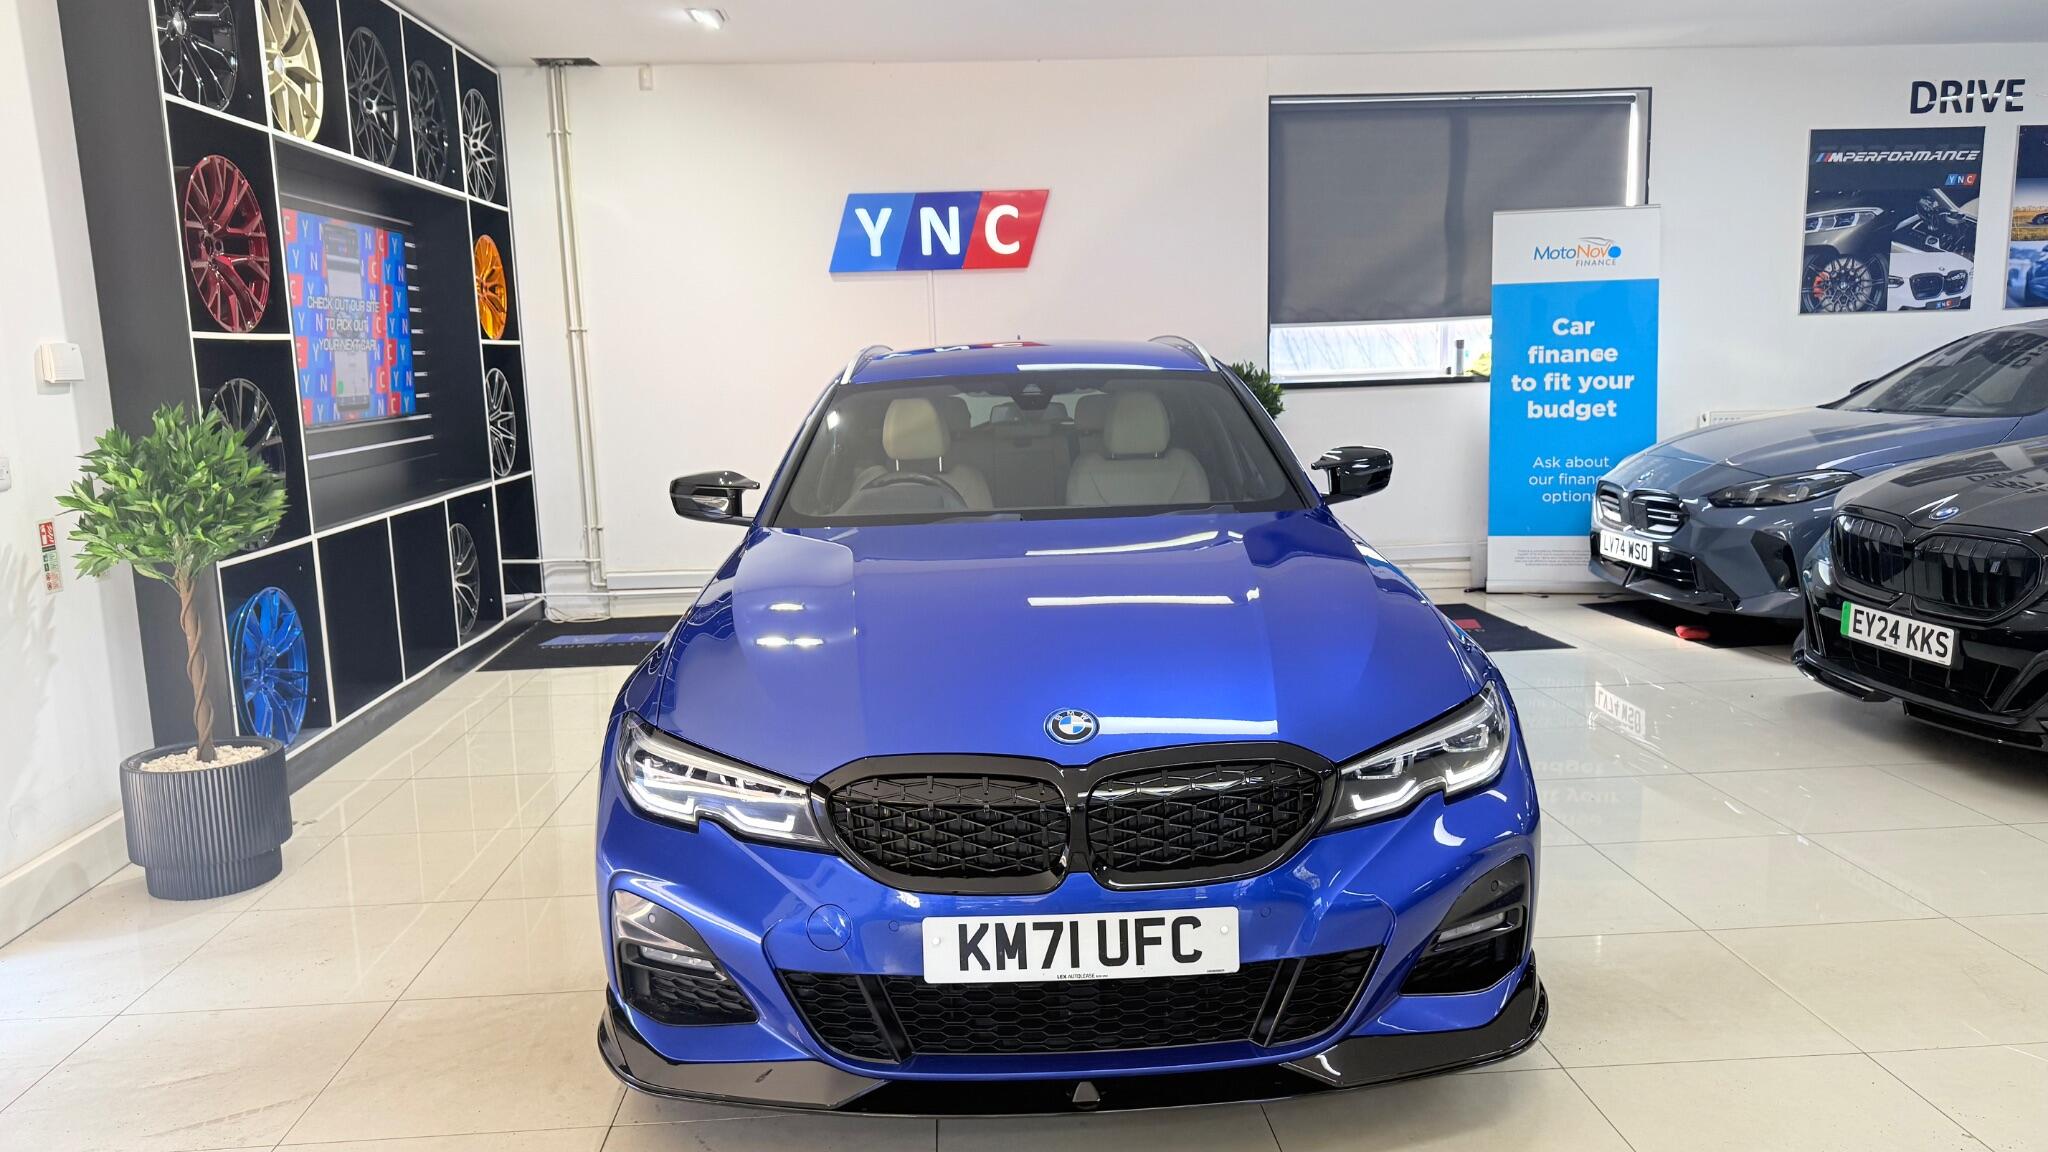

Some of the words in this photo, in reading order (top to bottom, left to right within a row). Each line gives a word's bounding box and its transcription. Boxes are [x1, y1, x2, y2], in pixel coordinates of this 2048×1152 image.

[1909, 79, 2026, 114] DRIVE
[855, 205, 1020, 257] YNC
[1575, 258, 1617, 268] FINANCE
[307, 295, 333, 310] CHECK
[334, 297, 349, 311] OUT
[350, 299, 365, 312] OUR
[366, 300, 380, 313] SITE
[325, 317, 336, 330] TO
[336, 318, 353, 331] PICK
[1552, 317, 1595, 336] Car
[1527, 345, 1618, 364] finance
[1511, 374, 1537, 392] to
[1543, 372, 1571, 391] fit
[1577, 373, 1636, 394] your
[1527, 400, 1617, 421] budget
[1532, 456, 1561, 468] Ask
[1565, 455, 1610, 468] about
[1528, 475, 1554, 486] our
[1558, 472, 1601, 486] financ
[1604, 534, 1626, 556] LV74
[1628, 541, 1648, 562] WSO
[1852, 608, 1901, 645] EY24
[1905, 622, 1950, 658] KKS
[957, 920, 1080, 972] KM71
[1097, 915, 1203, 967] UFC
